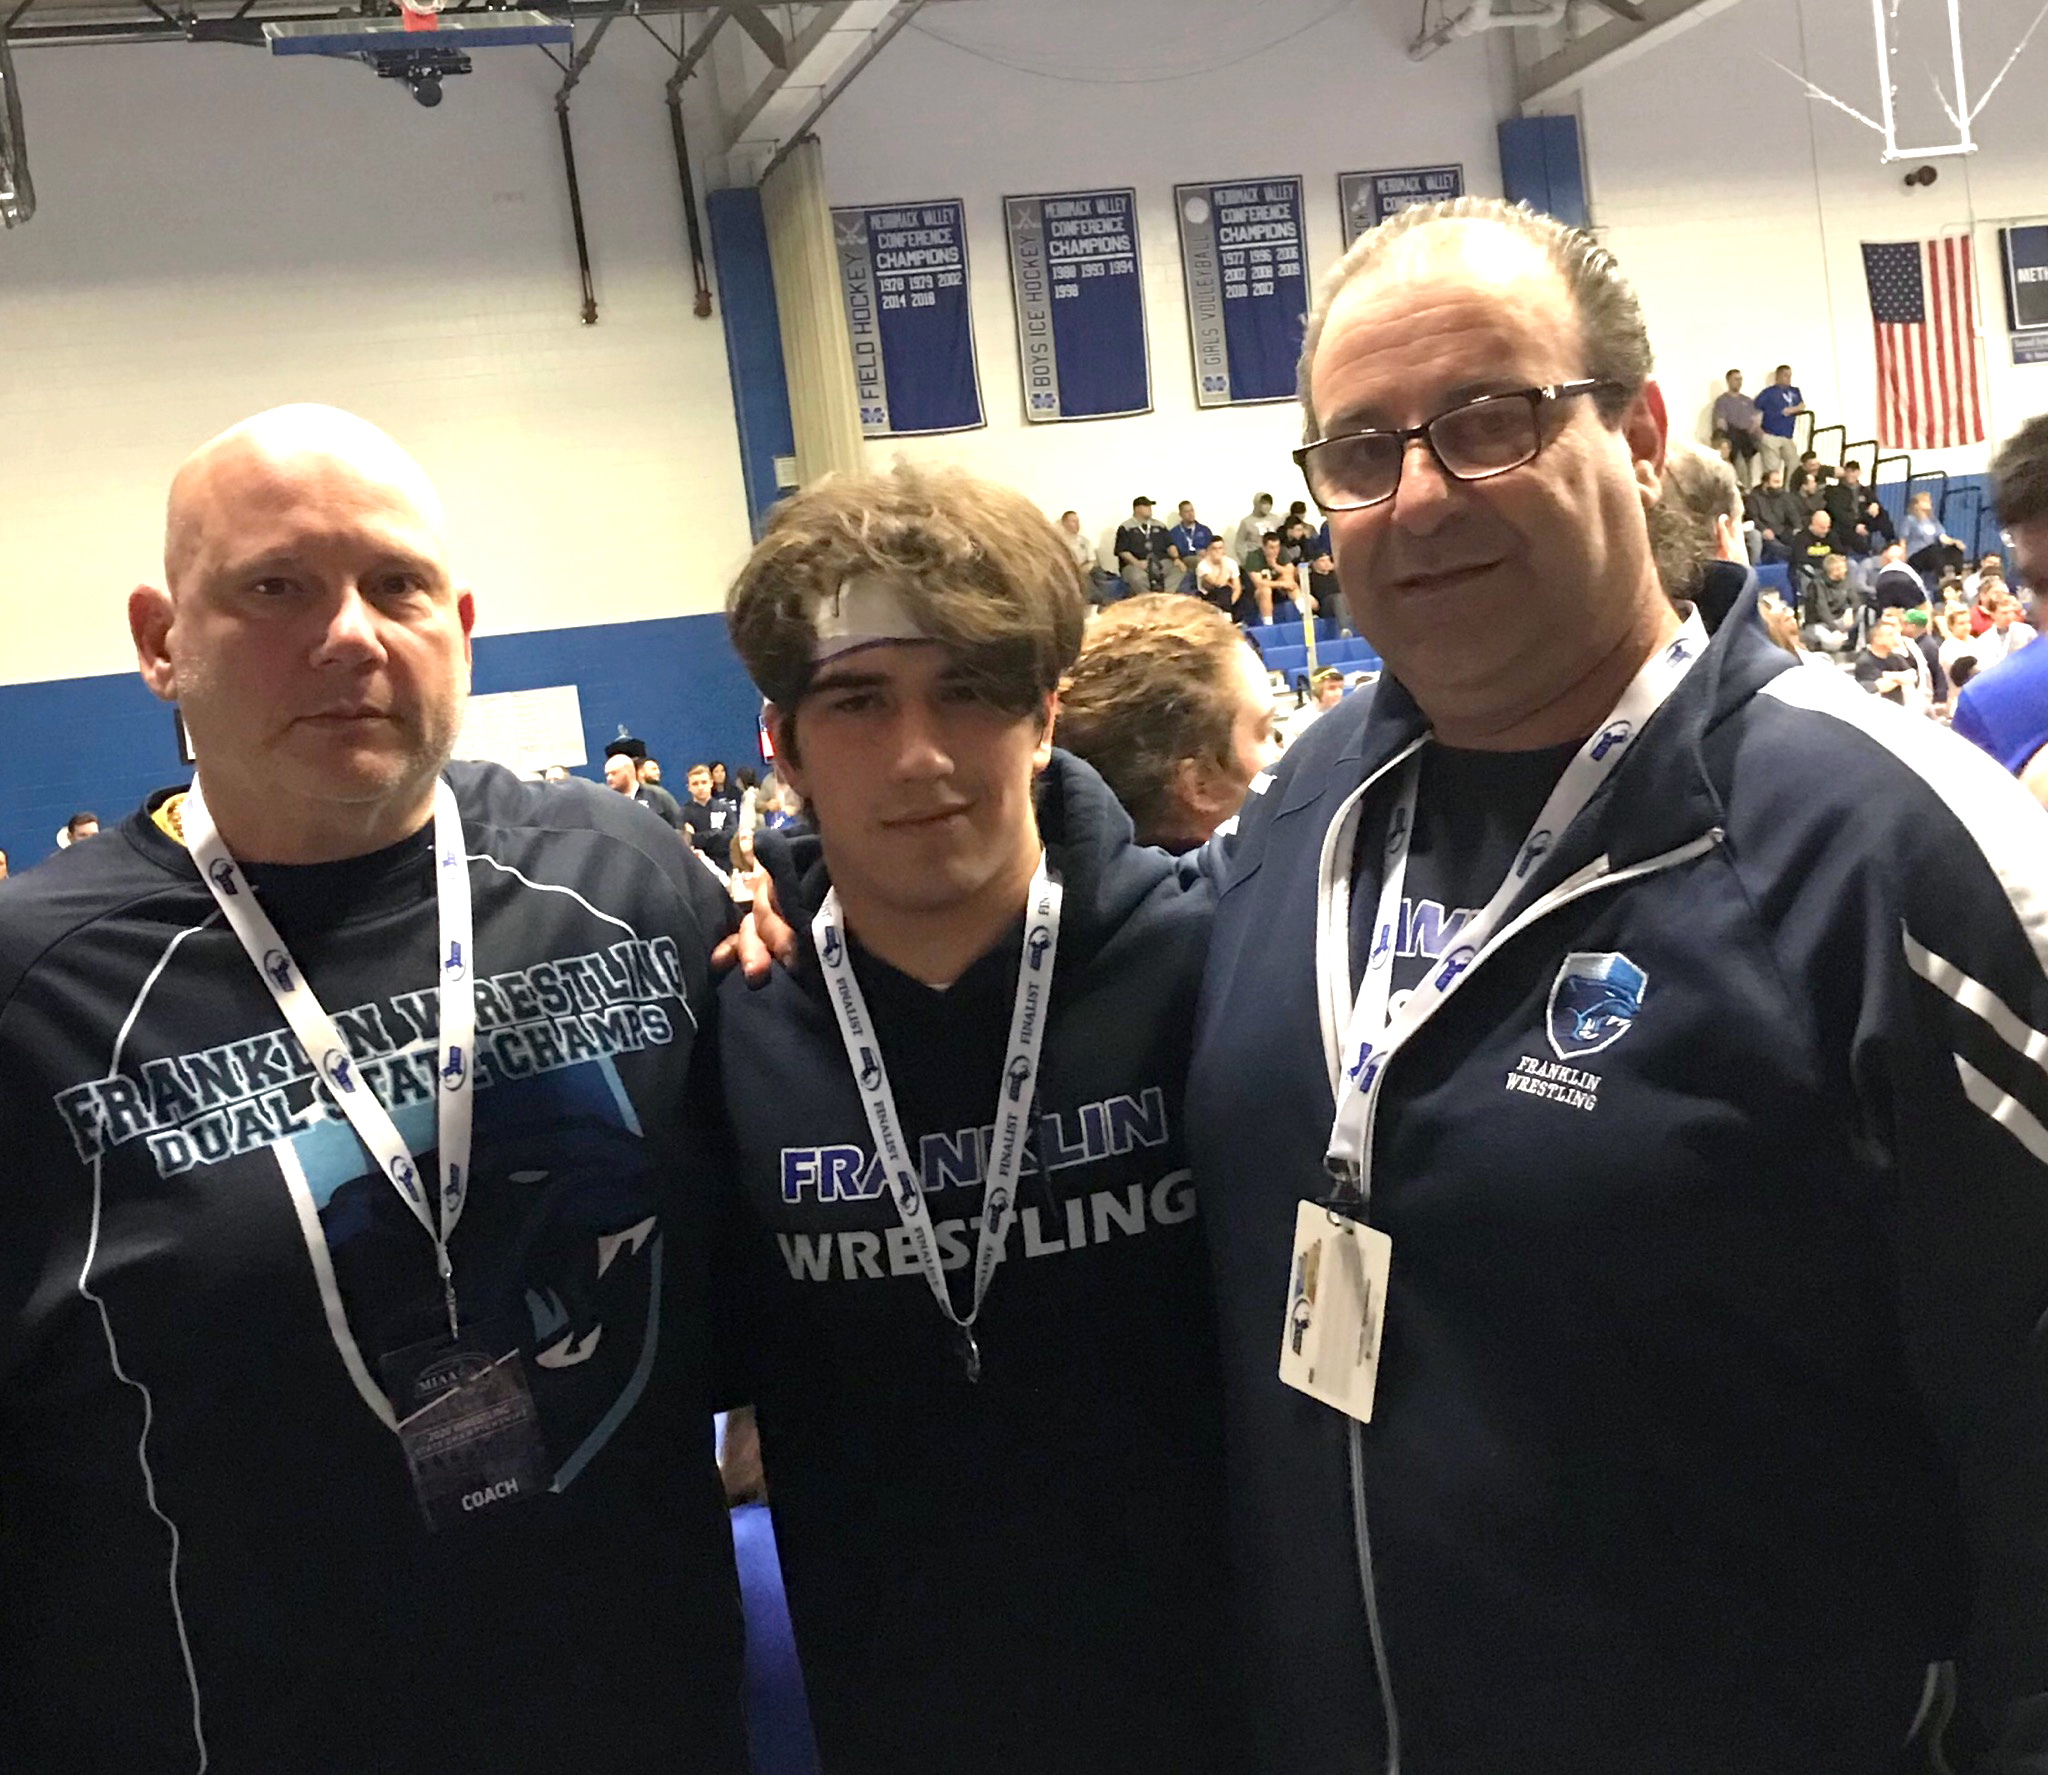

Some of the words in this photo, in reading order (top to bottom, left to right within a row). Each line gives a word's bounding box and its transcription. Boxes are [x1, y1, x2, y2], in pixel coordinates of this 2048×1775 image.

[1214, 188, 1260, 206] MERRIMACK
[1264, 184, 1293, 202] VALLEY
[1425, 173, 1455, 190] VALLEY
[870, 212, 919, 230] MERRIMACK
[922, 208, 954, 226] VALLEY
[1044, 200, 1092, 219] MERRIMACK
[1096, 196, 1127, 214] VALLEY
[1221, 203, 1292, 223] CONFERENCE
[878, 228, 953, 250] CONFERENCE
[1051, 216, 1125, 237] CONFERENCE
[1220, 222, 1297, 243] CHAMPIONS
[876, 246, 960, 269] CHAMPIONS
[1049, 234, 1131, 256] CHAMPIONS
[1222, 251, 1245, 266] 1977
[1020, 235, 1043, 302] HOCKEY
[1109, 260, 1134, 275] 1994
[1194, 234, 1216, 321] VOLLEYBALL
[844, 253, 872, 335] HOCKEY
[882, 294, 906, 310] 2014
[1027, 310, 1046, 336] ICE
[1202, 328, 1222, 366] GIRLS
[856, 342, 880, 400] FIELD
[1031, 343, 1051, 388] BOYS
[836, 977, 864, 1037] FINALIST
[1020, 981, 1039, 1045] FINALIST
[53, 1002, 397, 1165] FRANKLN
[146, 1089, 314, 1179] DUAL
[488, 1004, 673, 1080] CHAMPS
[1516, 1056, 1602, 1092] FRANKLIN
[1506, 1072, 1598, 1112] WRESTLING
[874, 1101, 899, 1161] FINALIST
[999, 1112, 1019, 1177] FINALIST
[461, 1477, 520, 1512] COACH
